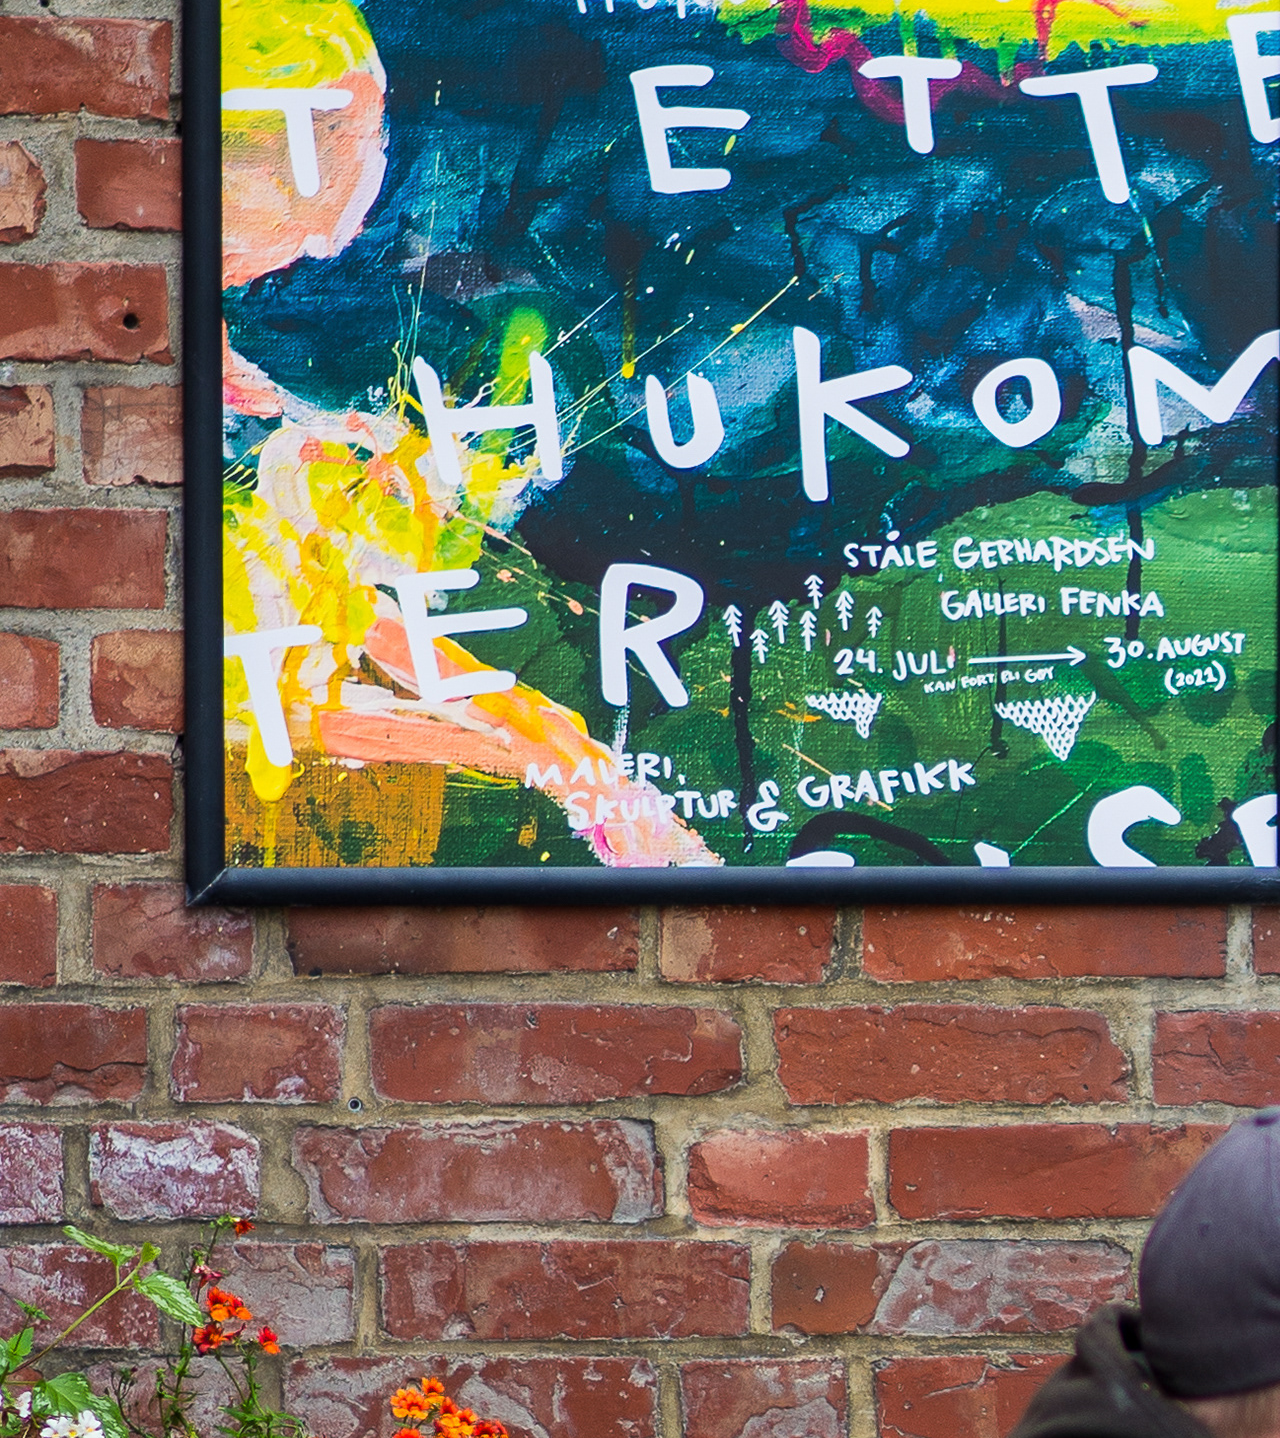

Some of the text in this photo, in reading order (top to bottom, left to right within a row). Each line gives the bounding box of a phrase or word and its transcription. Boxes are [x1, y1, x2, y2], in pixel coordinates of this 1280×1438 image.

[843, 530, 1155, 572] STÅLE GERHARDSEN
[941, 586, 1164, 620] GALLERI FENKA
[833, 647, 883, 675] 24.
[892, 647, 955, 681] JULI
[923, 680, 957, 694] KAN
[961, 673, 995, 689] FORT
[563, 789, 738, 831] SKULPTUR
[748, 780, 789, 832] &
[797, 759, 976, 809] GRAFIKK
